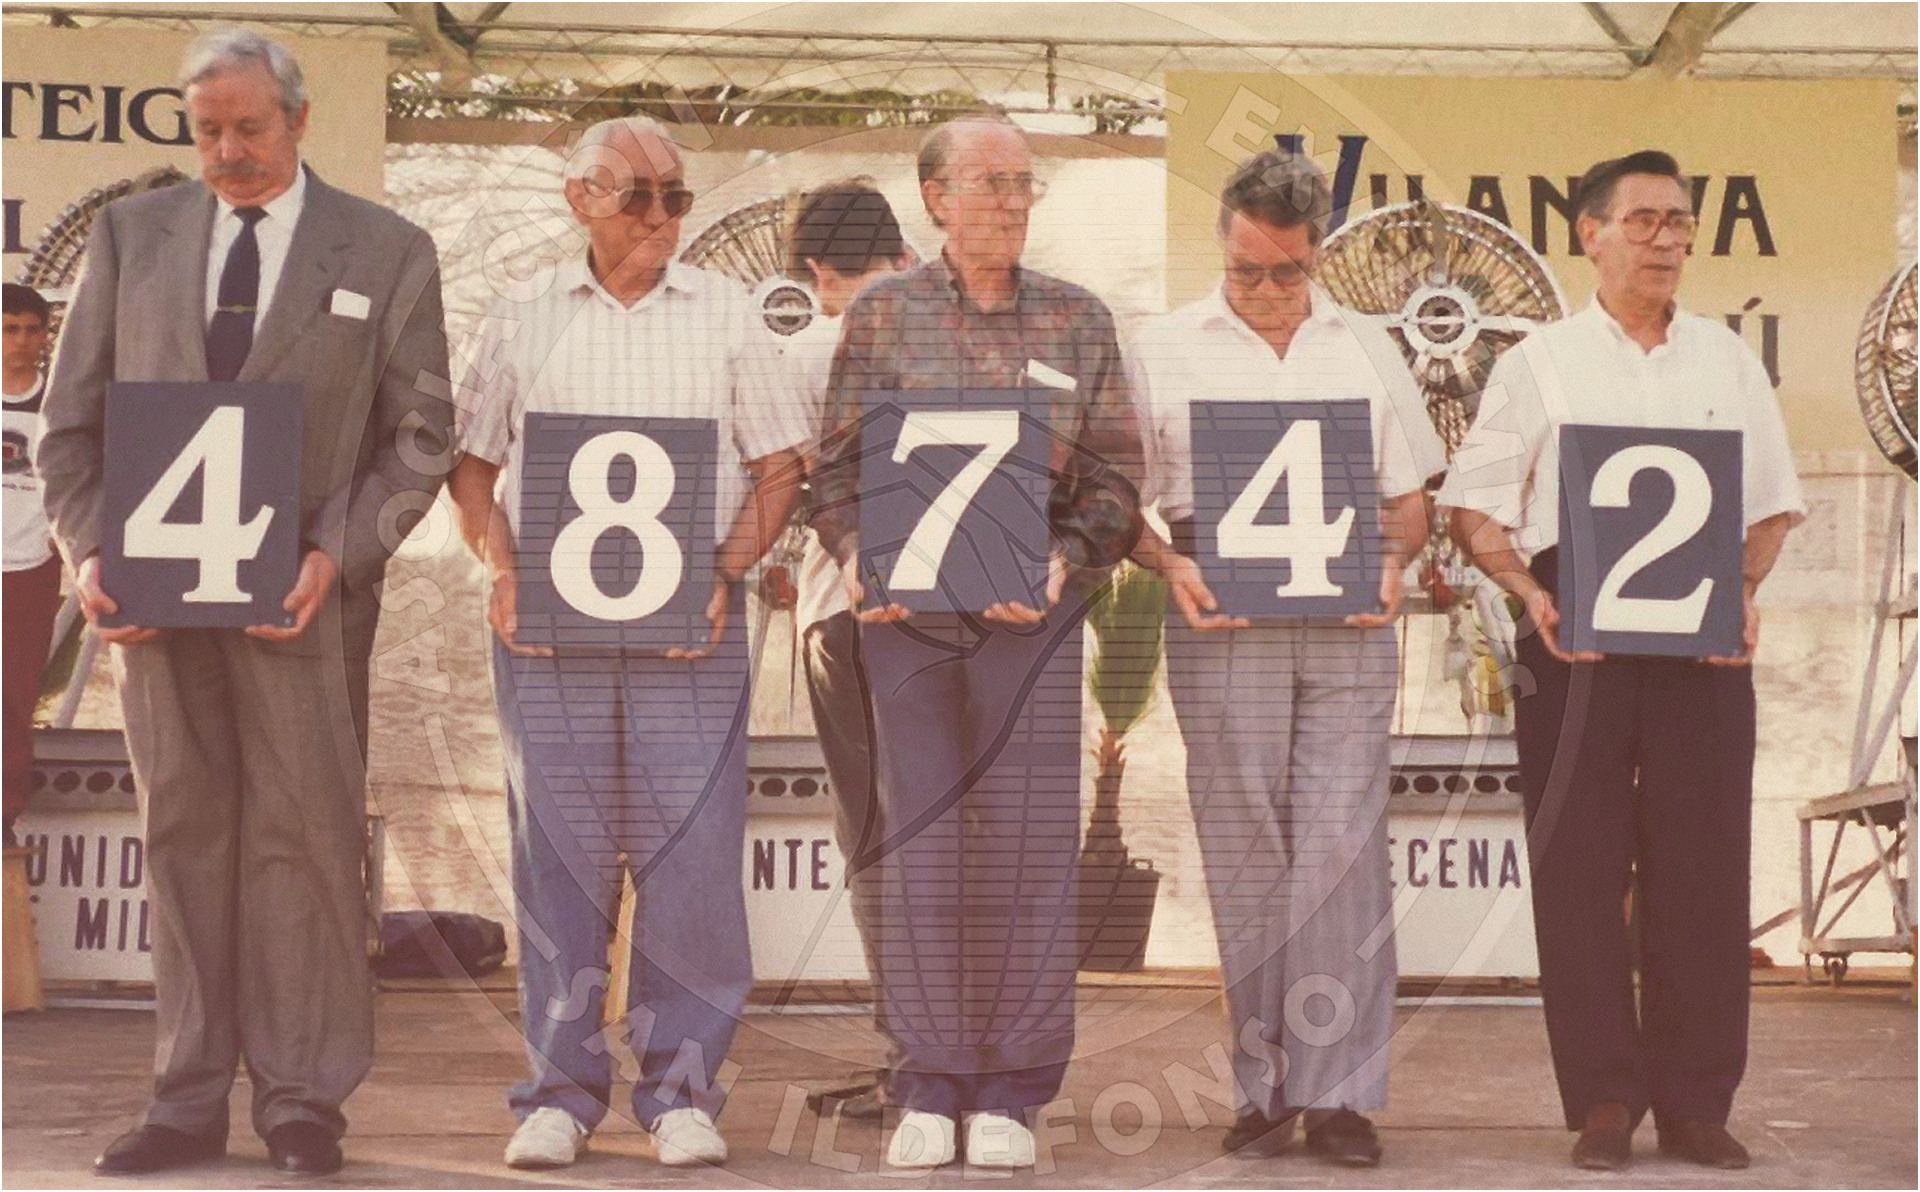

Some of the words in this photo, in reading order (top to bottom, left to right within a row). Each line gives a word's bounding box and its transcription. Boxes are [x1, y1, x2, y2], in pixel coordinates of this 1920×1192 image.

[124, 407, 274, 603] 4
[551, 431, 682, 620] 8
[889, 411, 1019, 590] 7
[1217, 420, 1355, 597] 4
[1590, 445, 1713, 633] 2
[75, 897, 152, 952] MIL
